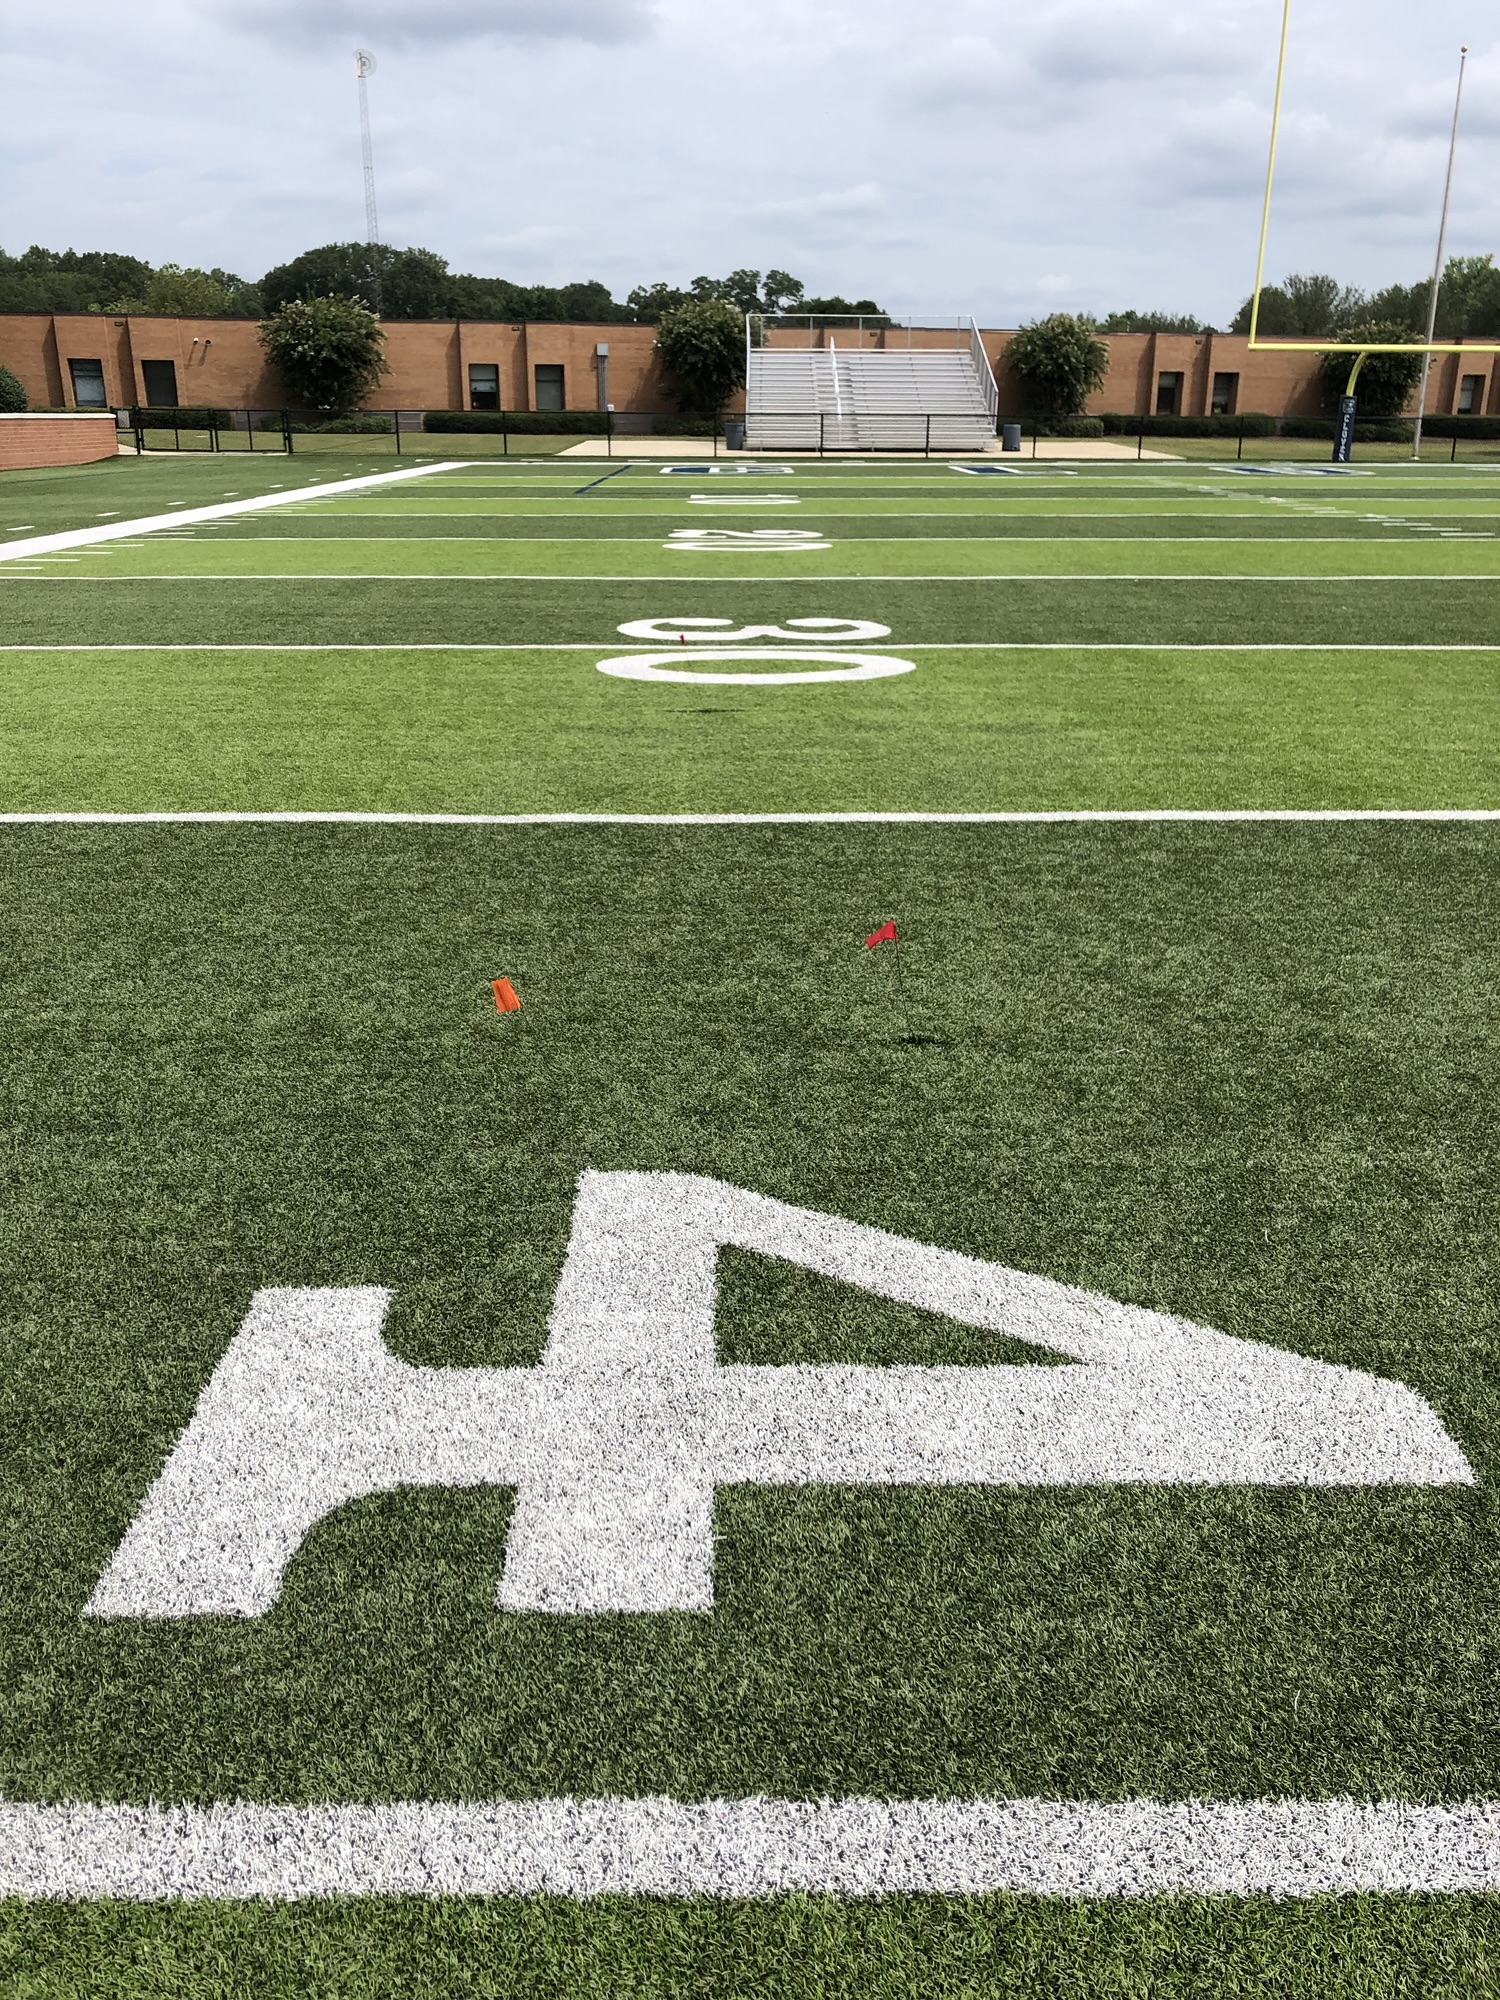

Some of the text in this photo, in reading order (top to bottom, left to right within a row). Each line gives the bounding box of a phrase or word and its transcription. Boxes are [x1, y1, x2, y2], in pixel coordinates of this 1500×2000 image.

[662, 529, 833, 551] 20
[596, 617, 917, 685] 30
[83, 1169, 1476, 1616] 4
